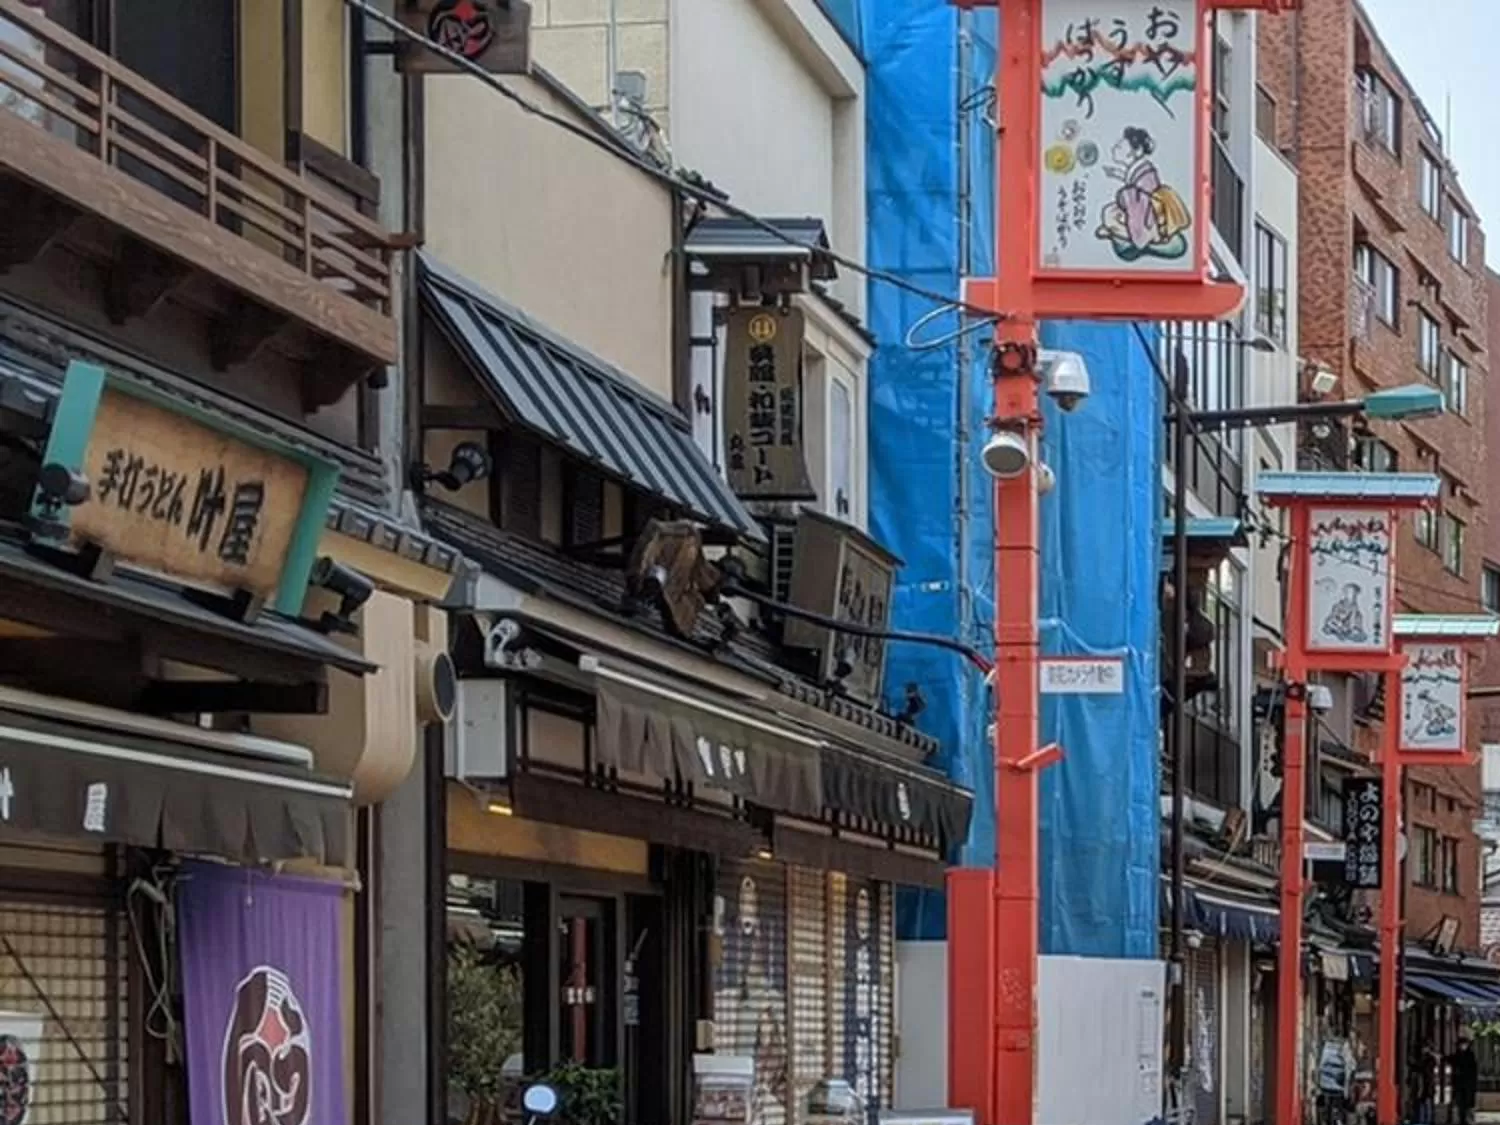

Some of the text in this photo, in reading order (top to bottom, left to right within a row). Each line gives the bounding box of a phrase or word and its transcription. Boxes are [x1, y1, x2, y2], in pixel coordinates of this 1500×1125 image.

[98, 449, 187, 525] 手打うどん
